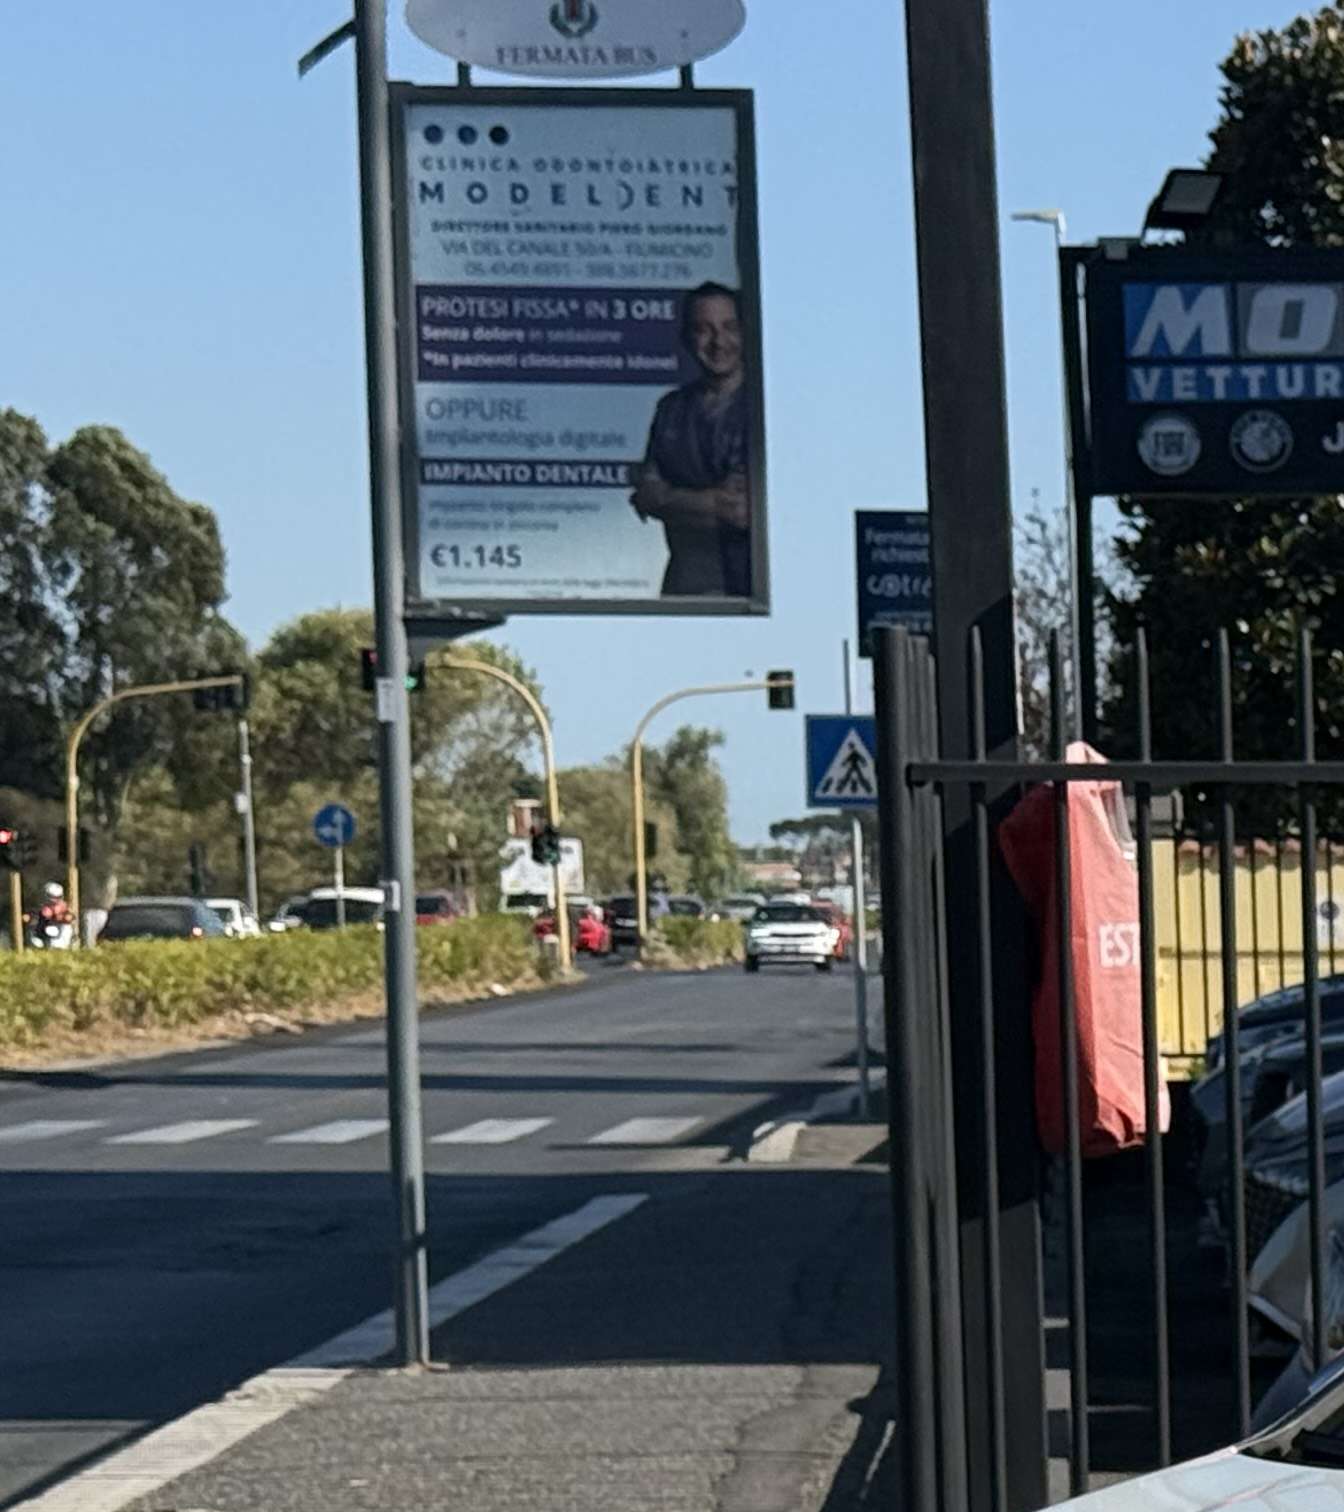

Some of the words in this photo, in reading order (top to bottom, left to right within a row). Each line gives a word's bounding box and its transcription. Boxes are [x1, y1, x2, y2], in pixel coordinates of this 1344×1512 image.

[496, 47, 608, 65] FERMATA
[420, 157, 520, 173] CLINICA
[533, 159, 735, 175] ODONTOIATRICA
[422, 297, 508, 319] PROTESI
[613, 300, 627, 320] 3
[630, 300, 676, 320] ORE
[425, 397, 529, 421] OPPURE
[424, 462, 531, 482] IMPIANTO
[535, 464, 630, 484] DENTALE
[431, 543, 523, 569] €1.145
